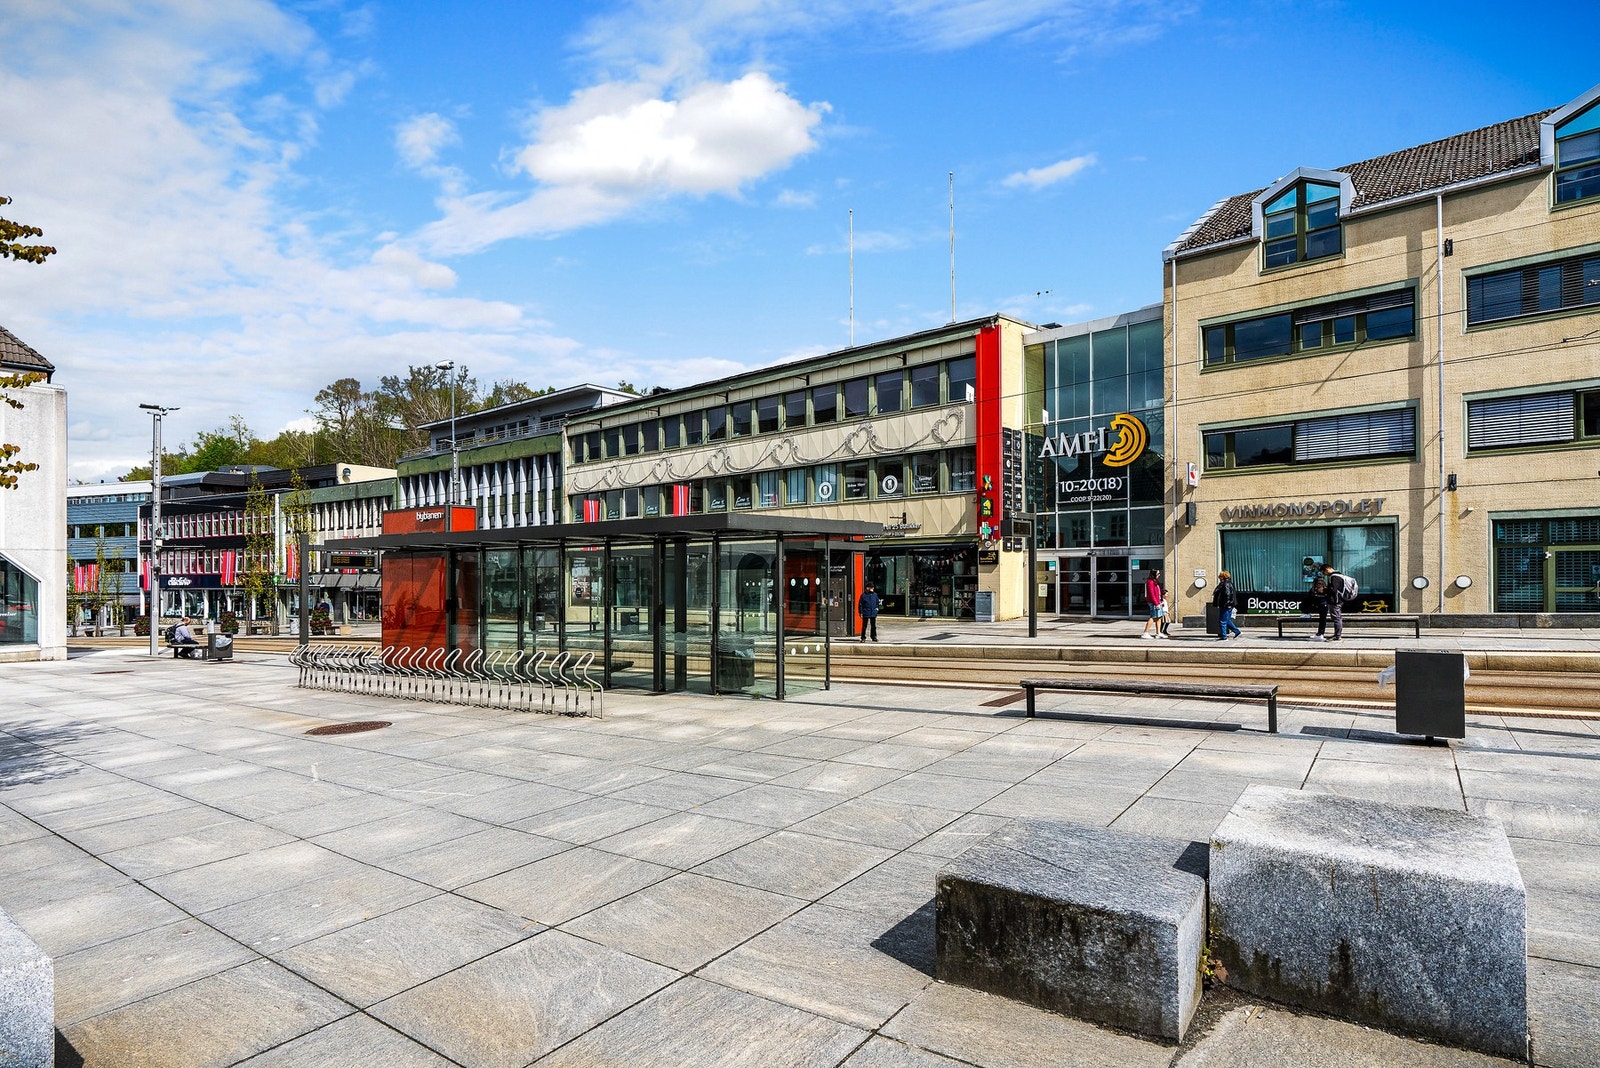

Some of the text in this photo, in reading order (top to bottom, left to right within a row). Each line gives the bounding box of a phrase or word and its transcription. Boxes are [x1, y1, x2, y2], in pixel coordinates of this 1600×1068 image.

[1038, 427, 1107, 458] AMFI
[1060, 477, 1122, 493] 10-20(18)
[416, 511, 442, 522] bybanen
[1225, 498, 1387, 519] VINMONOPOLET
[1247, 597, 1302, 610] Blomster
